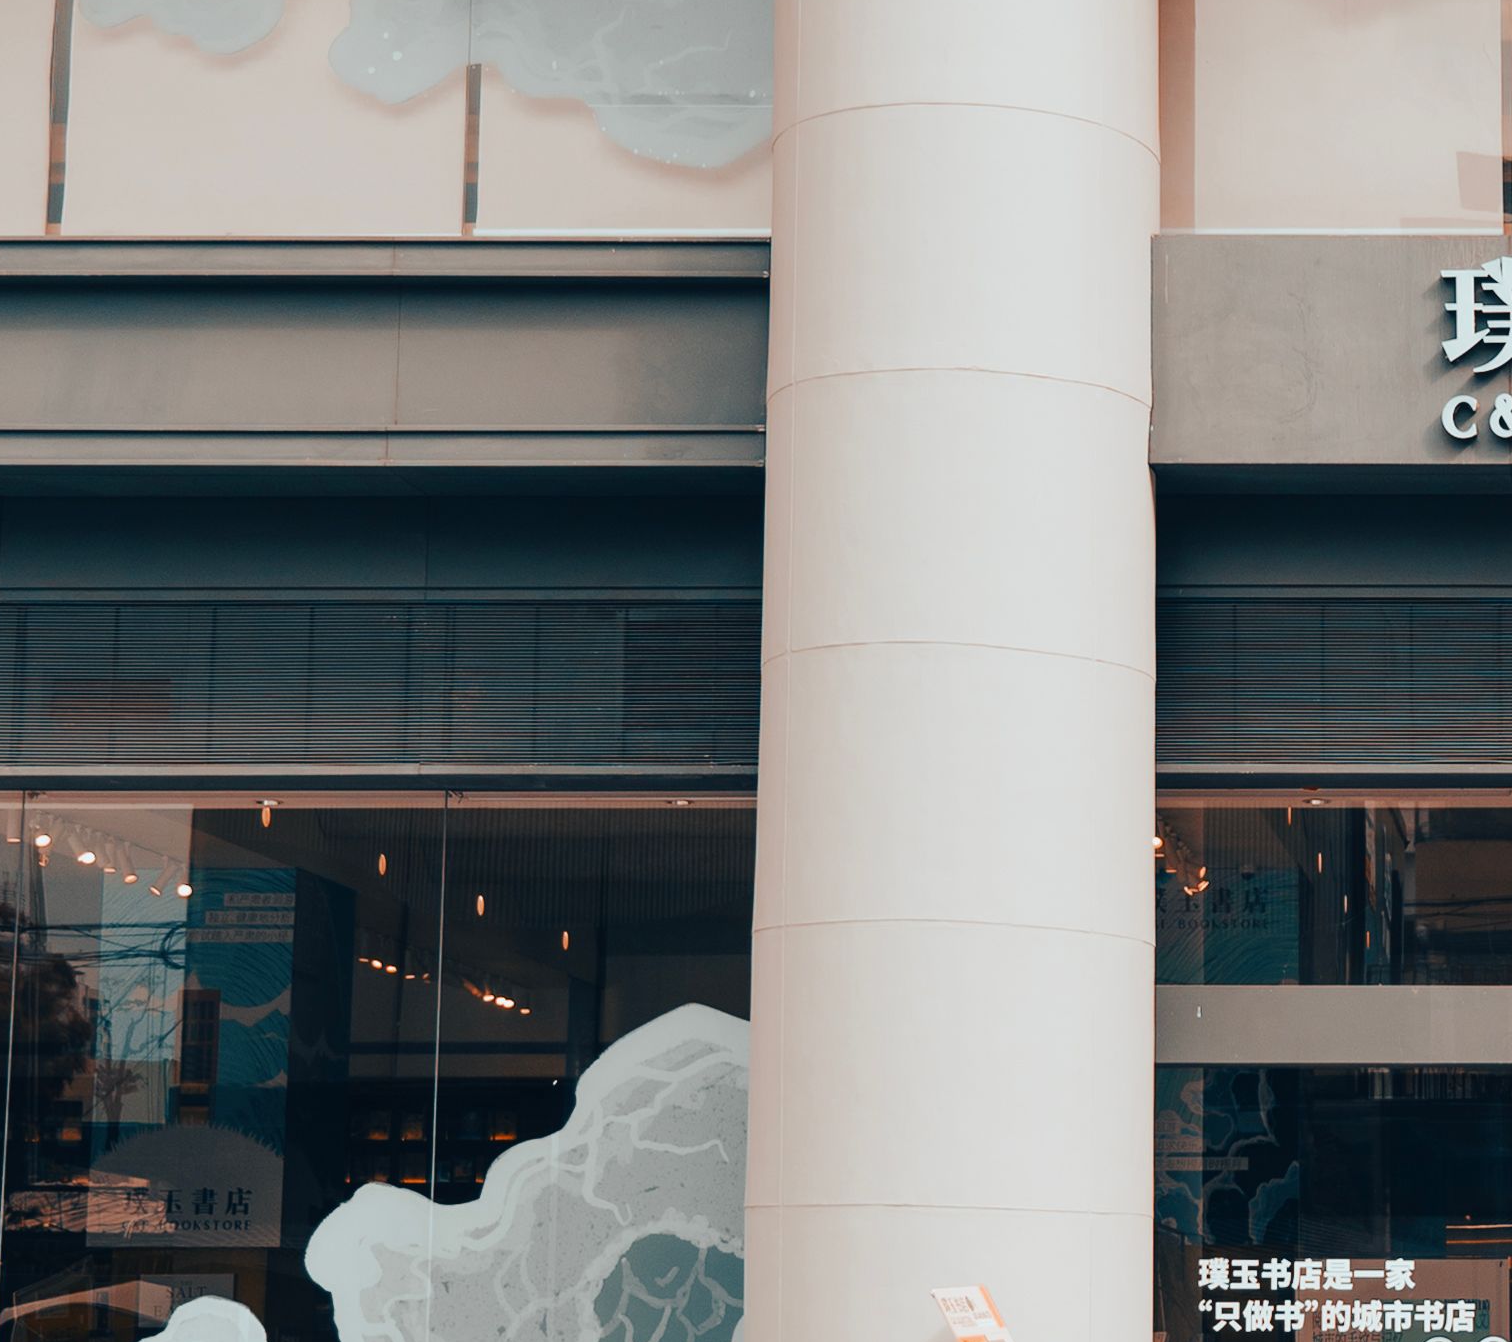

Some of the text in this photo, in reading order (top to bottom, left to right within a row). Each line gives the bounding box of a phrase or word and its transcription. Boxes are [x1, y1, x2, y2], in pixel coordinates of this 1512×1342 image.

[1197, 1257, 1416, 1291] 璞玉书店是一家
[1198, 1299, 1476, 1333] “只做书”的城市书店
